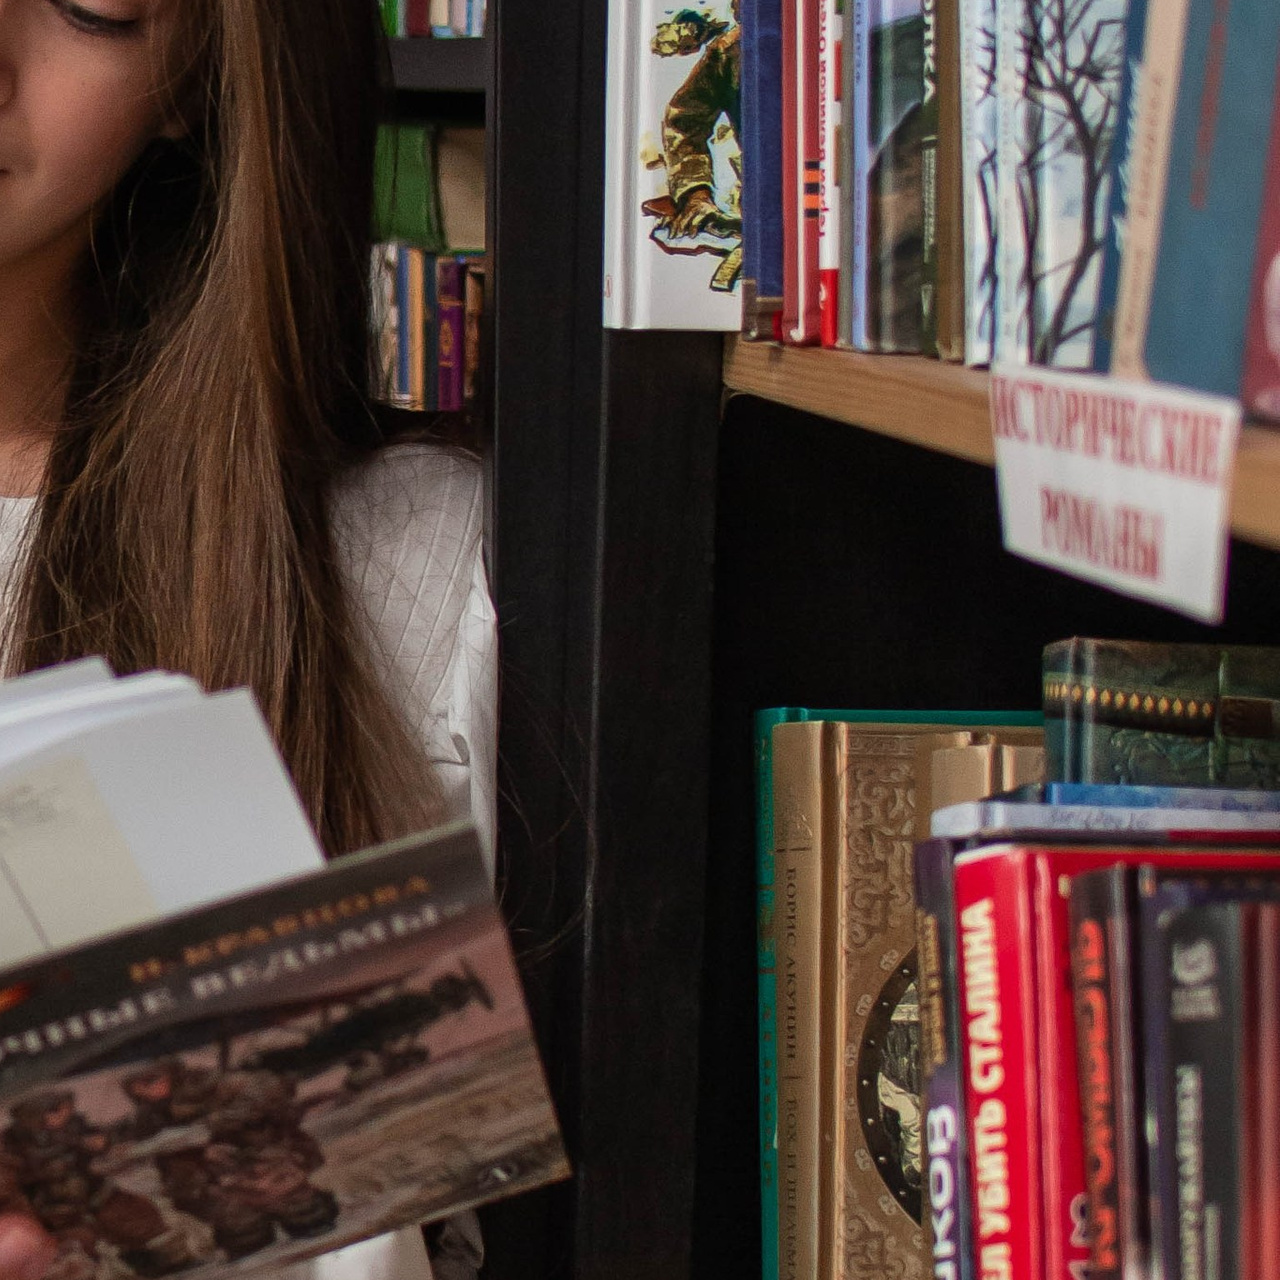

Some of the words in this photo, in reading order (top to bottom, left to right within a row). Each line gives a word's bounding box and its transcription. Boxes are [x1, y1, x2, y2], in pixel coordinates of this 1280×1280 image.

[785, 867, 797, 949] БОРИС
[785, 957, 797, 1061] АКУНИН
[960, 901, 1007, 1097] СТАЛИНА
[973, 1099, 1012, 1240] УБИТЬ
